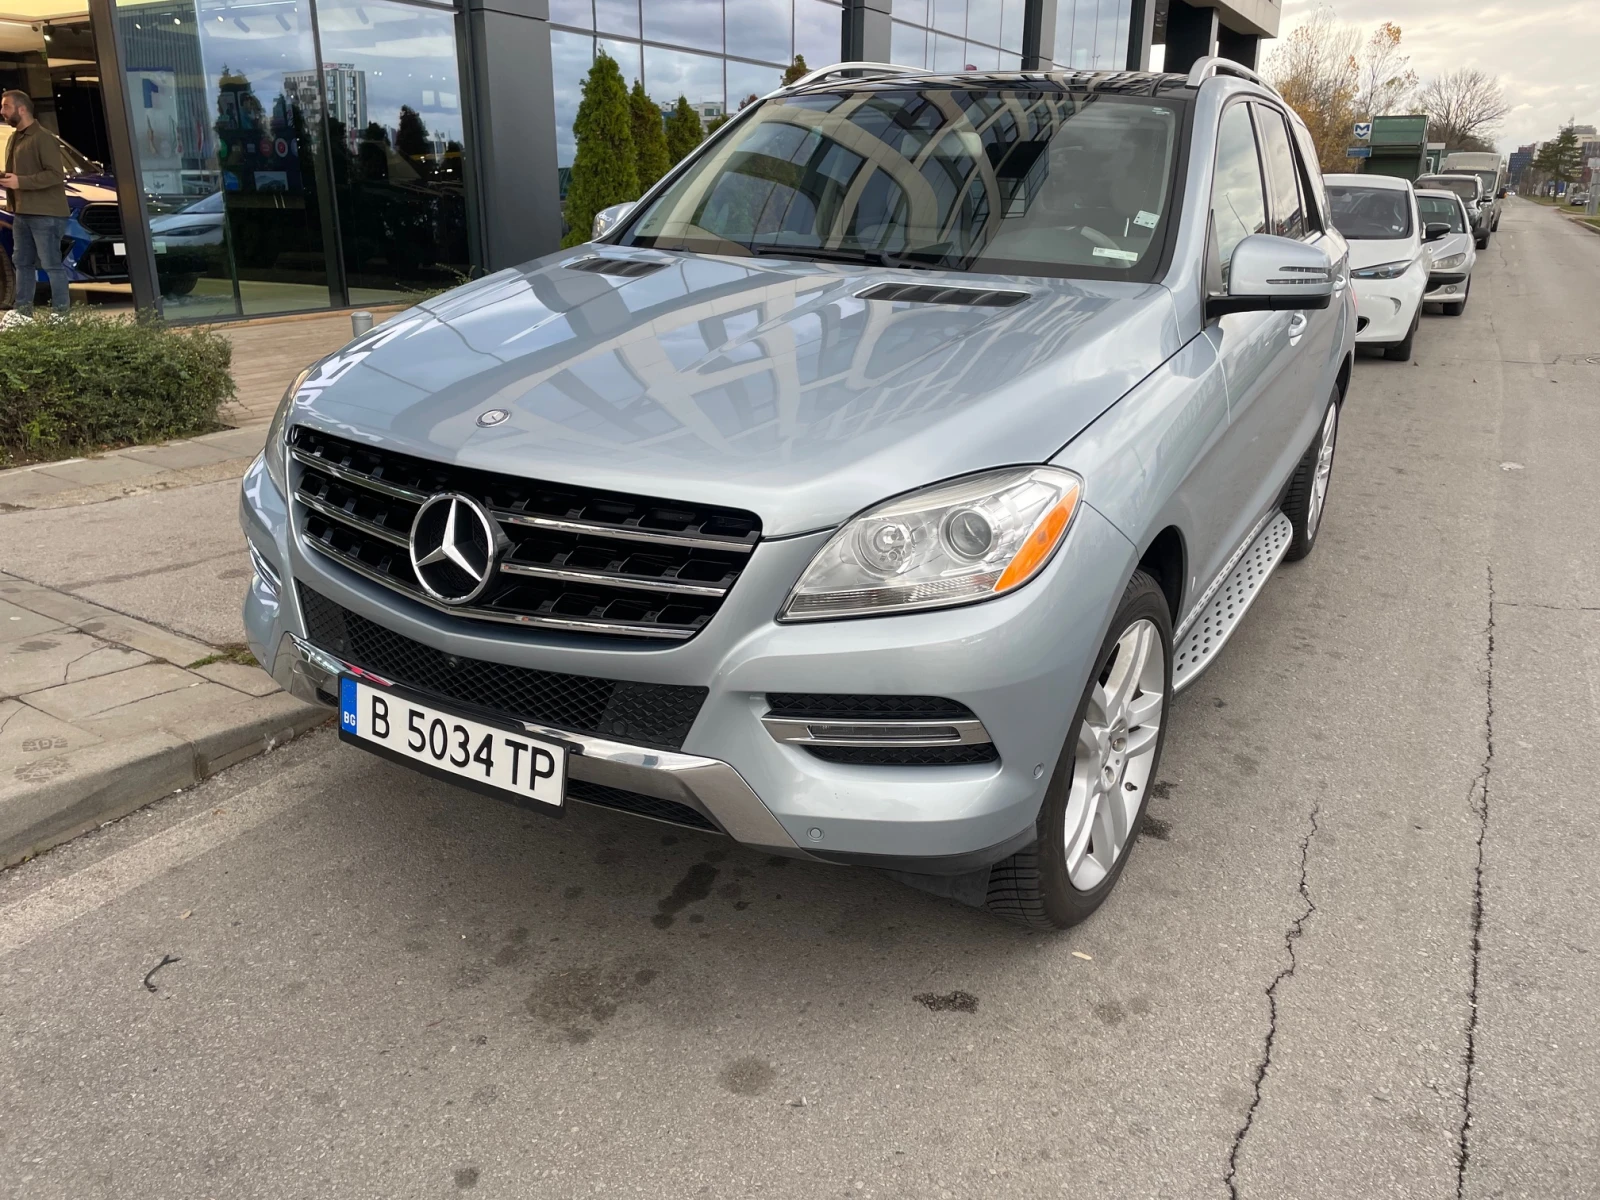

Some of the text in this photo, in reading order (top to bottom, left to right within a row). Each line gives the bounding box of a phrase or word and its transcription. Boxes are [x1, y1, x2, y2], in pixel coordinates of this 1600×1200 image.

[344, 711, 356, 727] BG
[372, 695, 555, 791] B 5034 TP
